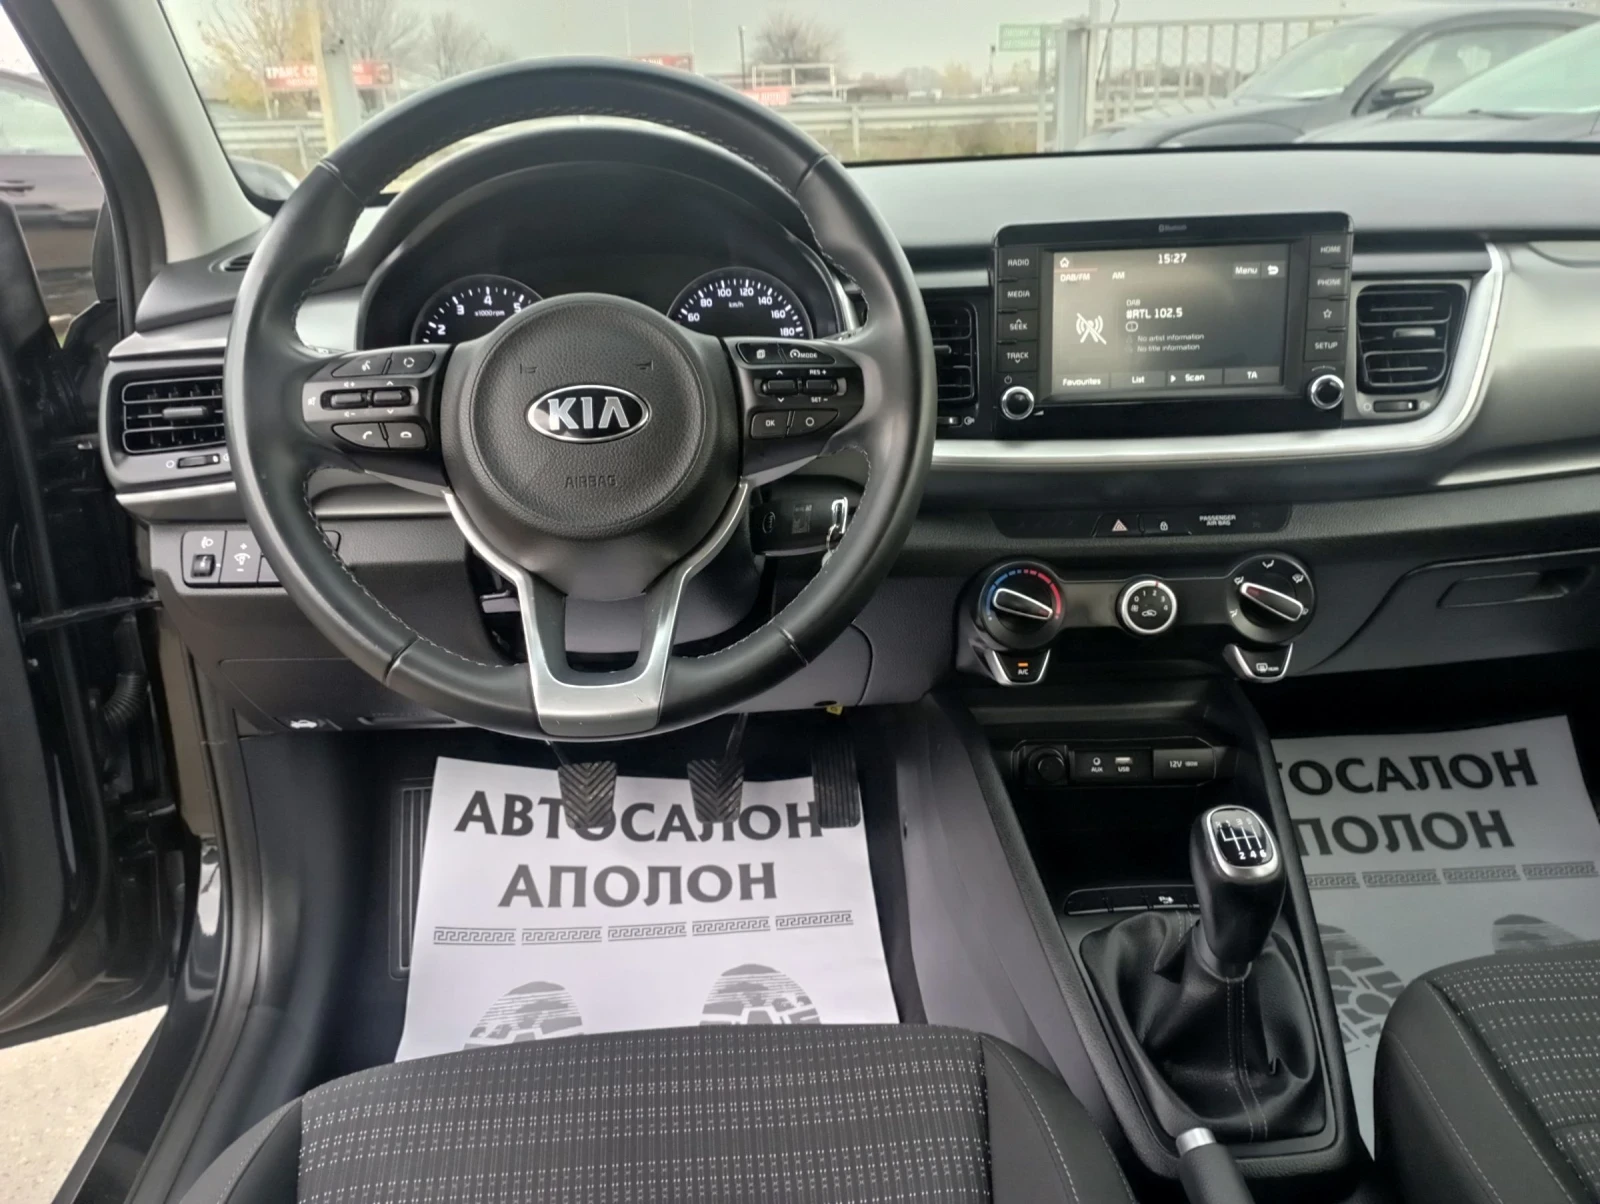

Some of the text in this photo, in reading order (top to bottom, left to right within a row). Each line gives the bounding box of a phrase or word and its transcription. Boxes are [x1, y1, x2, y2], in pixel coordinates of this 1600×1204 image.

[1320, 245, 1341, 254] HOME
[1007, 258, 1030, 267] RADIO
[1158, 252, 1187, 265] 15:27
[1112, 271, 1125, 280] AM
[1235, 266, 1258, 275] Menu
[1060, 272, 1091, 283] DAB/FM
[1317, 278, 1341, 287] PHONE
[717, 288, 732, 298] 100
[740, 287, 754, 297] 120
[1007, 289, 1031, 298] MEDIA
[483, 295, 492, 306] 4
[700, 298, 713, 308] 80
[758, 296, 773, 306] 140
[1126, 298, 1141, 306] DAB
[456, 304, 465, 316] 3
[513, 302, 521, 313] 5
[687, 312, 700, 322] 60
[771, 309, 786, 319] 160
[1154, 307, 1183, 319] 102.5
[437, 324, 446, 335] 2
[1009, 322, 1028, 331] SEEK
[780, 327, 795, 337] 180
[1166, 333, 1204, 341] information
[1148, 344, 1161, 352] title
[1162, 343, 1200, 351] information
[1314, 341, 1338, 350] SETUP
[1006, 352, 1029, 360] TRACK
[1132, 375, 1145, 384] List
[1185, 373, 1205, 382] Scan
[1247, 371, 1258, 380] TA
[1062, 377, 1102, 387] Favourites
[547, 396, 630, 431] KIA
[765, 419, 775, 427] OK
[564, 474, 617, 489] AIRBAG
[1199, 513, 1237, 522] PASSENGER
[1169, 760, 1183, 769] 12V
[1277, 748, 1538, 796] ОСАЛОН
[1238, 851, 1246, 860] 2
[1249, 850, 1257, 859] 4
[497, 861, 778, 908] АПОЛОН
